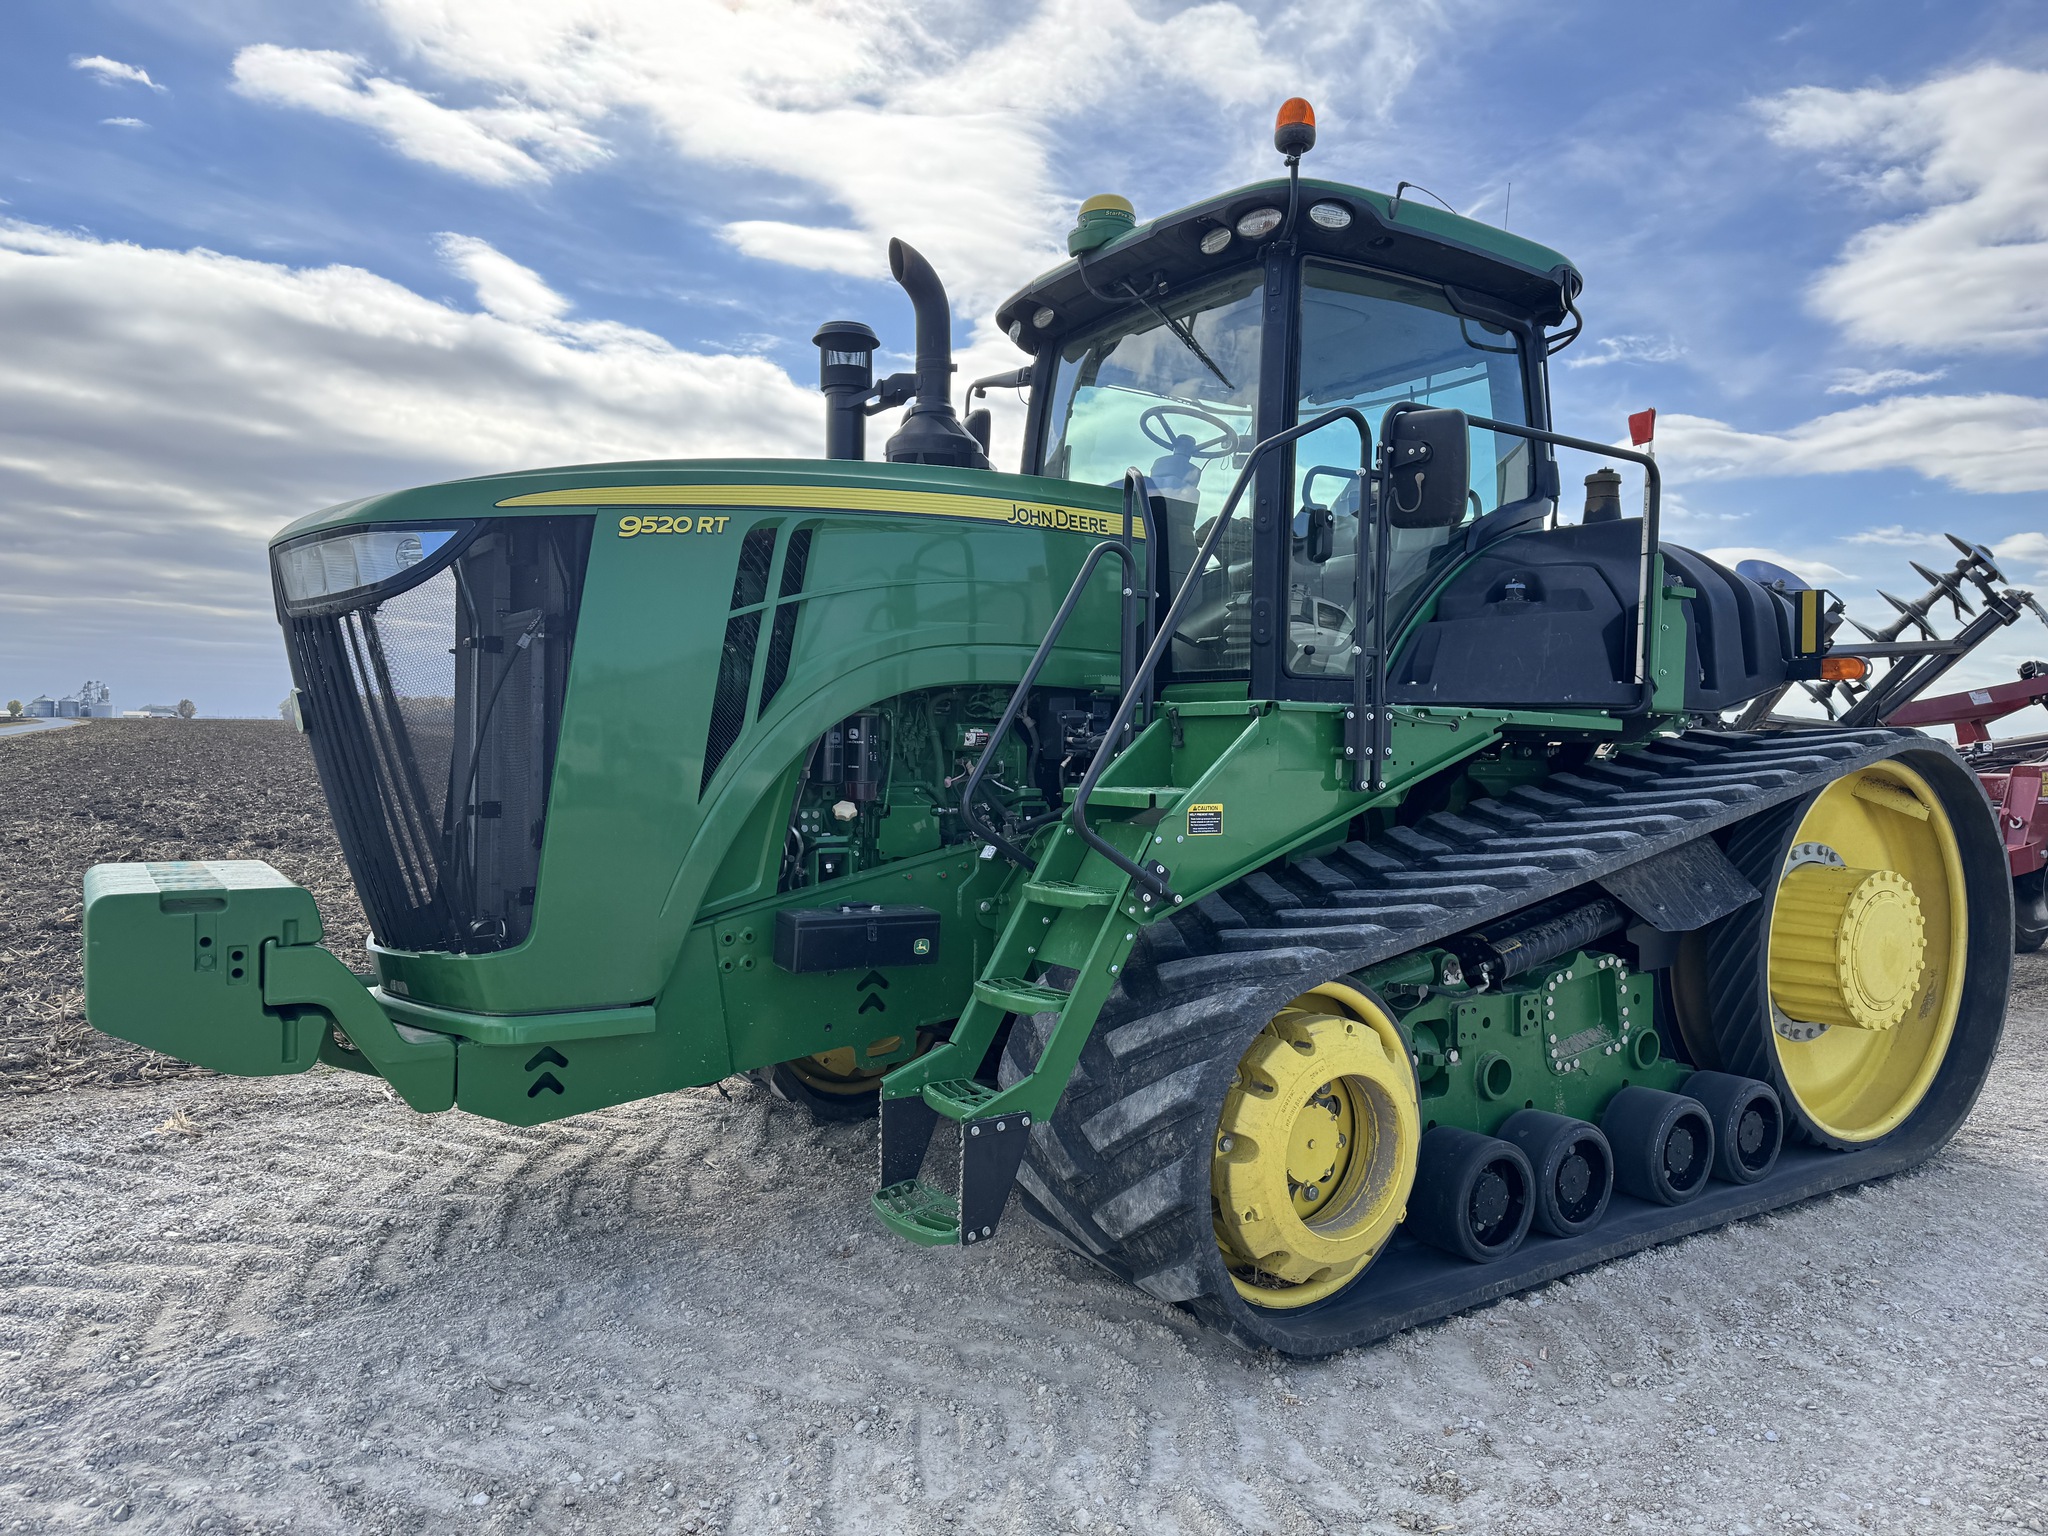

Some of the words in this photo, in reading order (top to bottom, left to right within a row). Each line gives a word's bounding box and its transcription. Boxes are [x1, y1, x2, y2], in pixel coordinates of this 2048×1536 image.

[618, 515, 693, 538] 9520
[696, 516, 730, 534] RT
[1007, 503, 1053, 527] JOHN
[1055, 509, 1109, 533] DEERE
